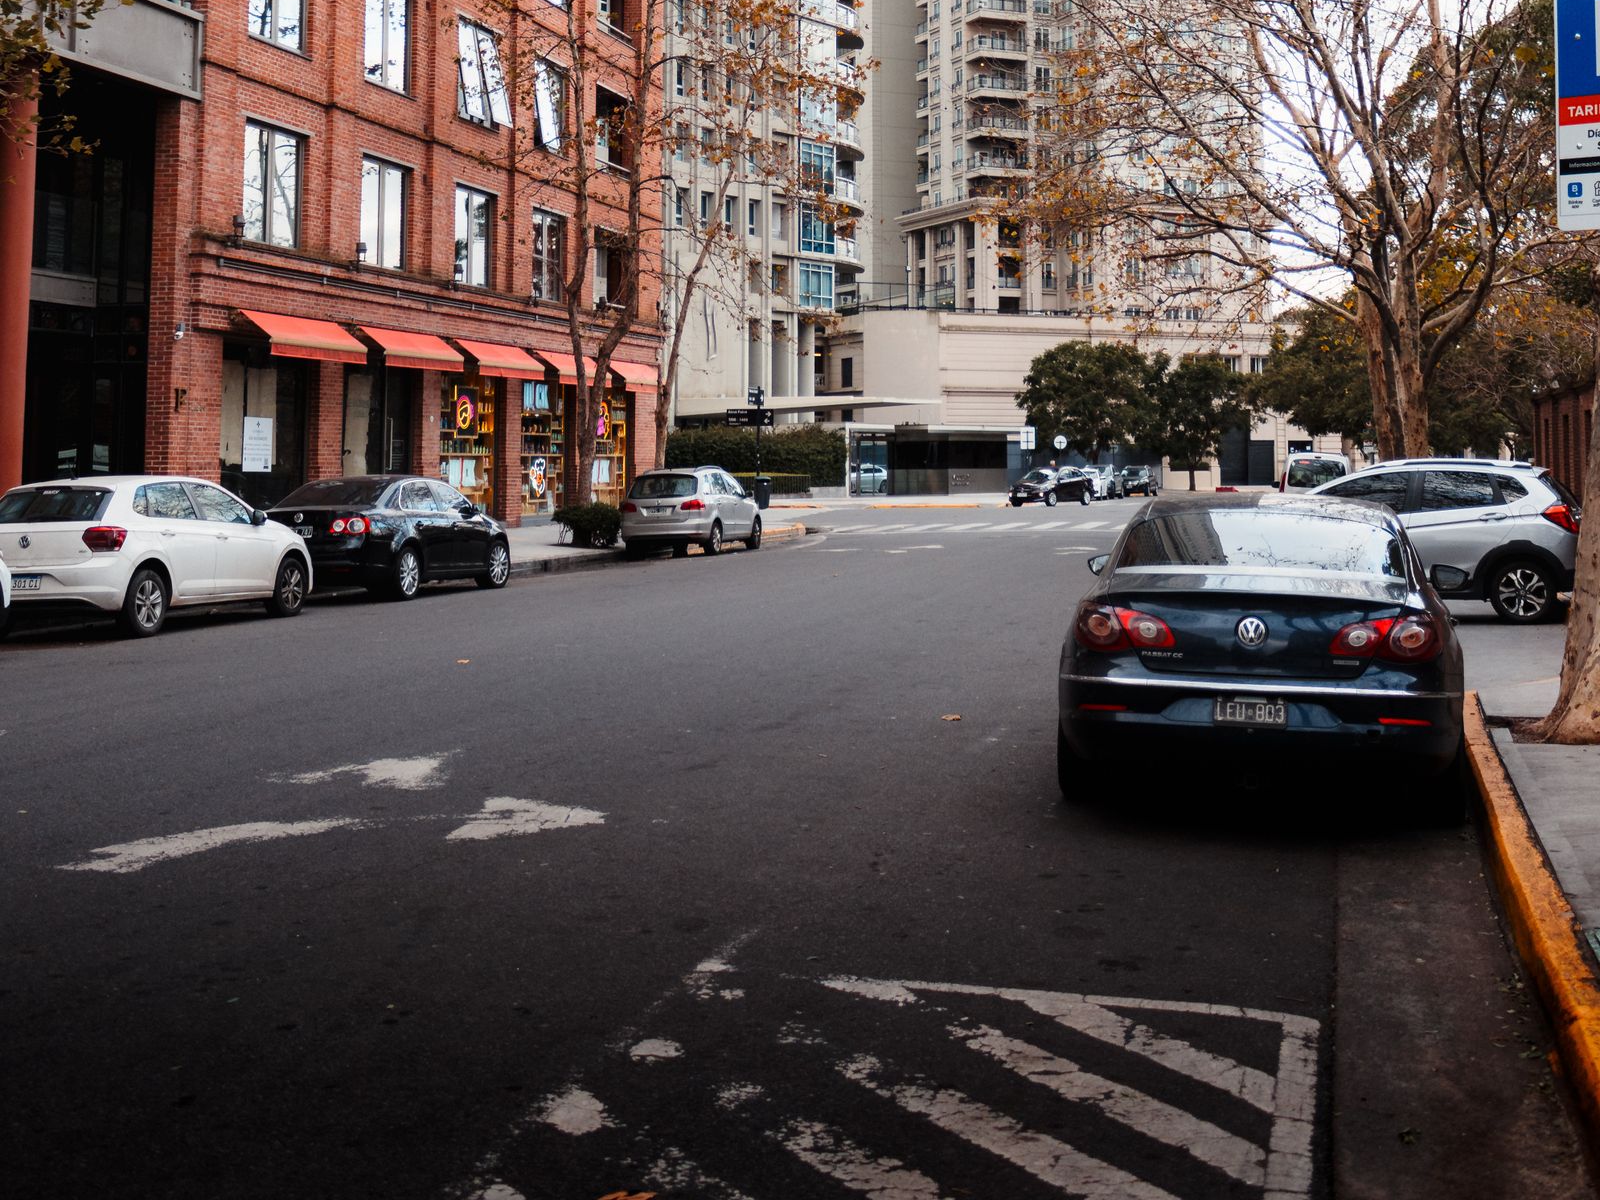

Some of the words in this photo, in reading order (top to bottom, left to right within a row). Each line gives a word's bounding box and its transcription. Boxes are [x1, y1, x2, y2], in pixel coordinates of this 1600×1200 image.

[1567, 103, 1600, 118] TARI
[1216, 701, 1245, 721] LEU
[1255, 703, 1285, 723] 803
